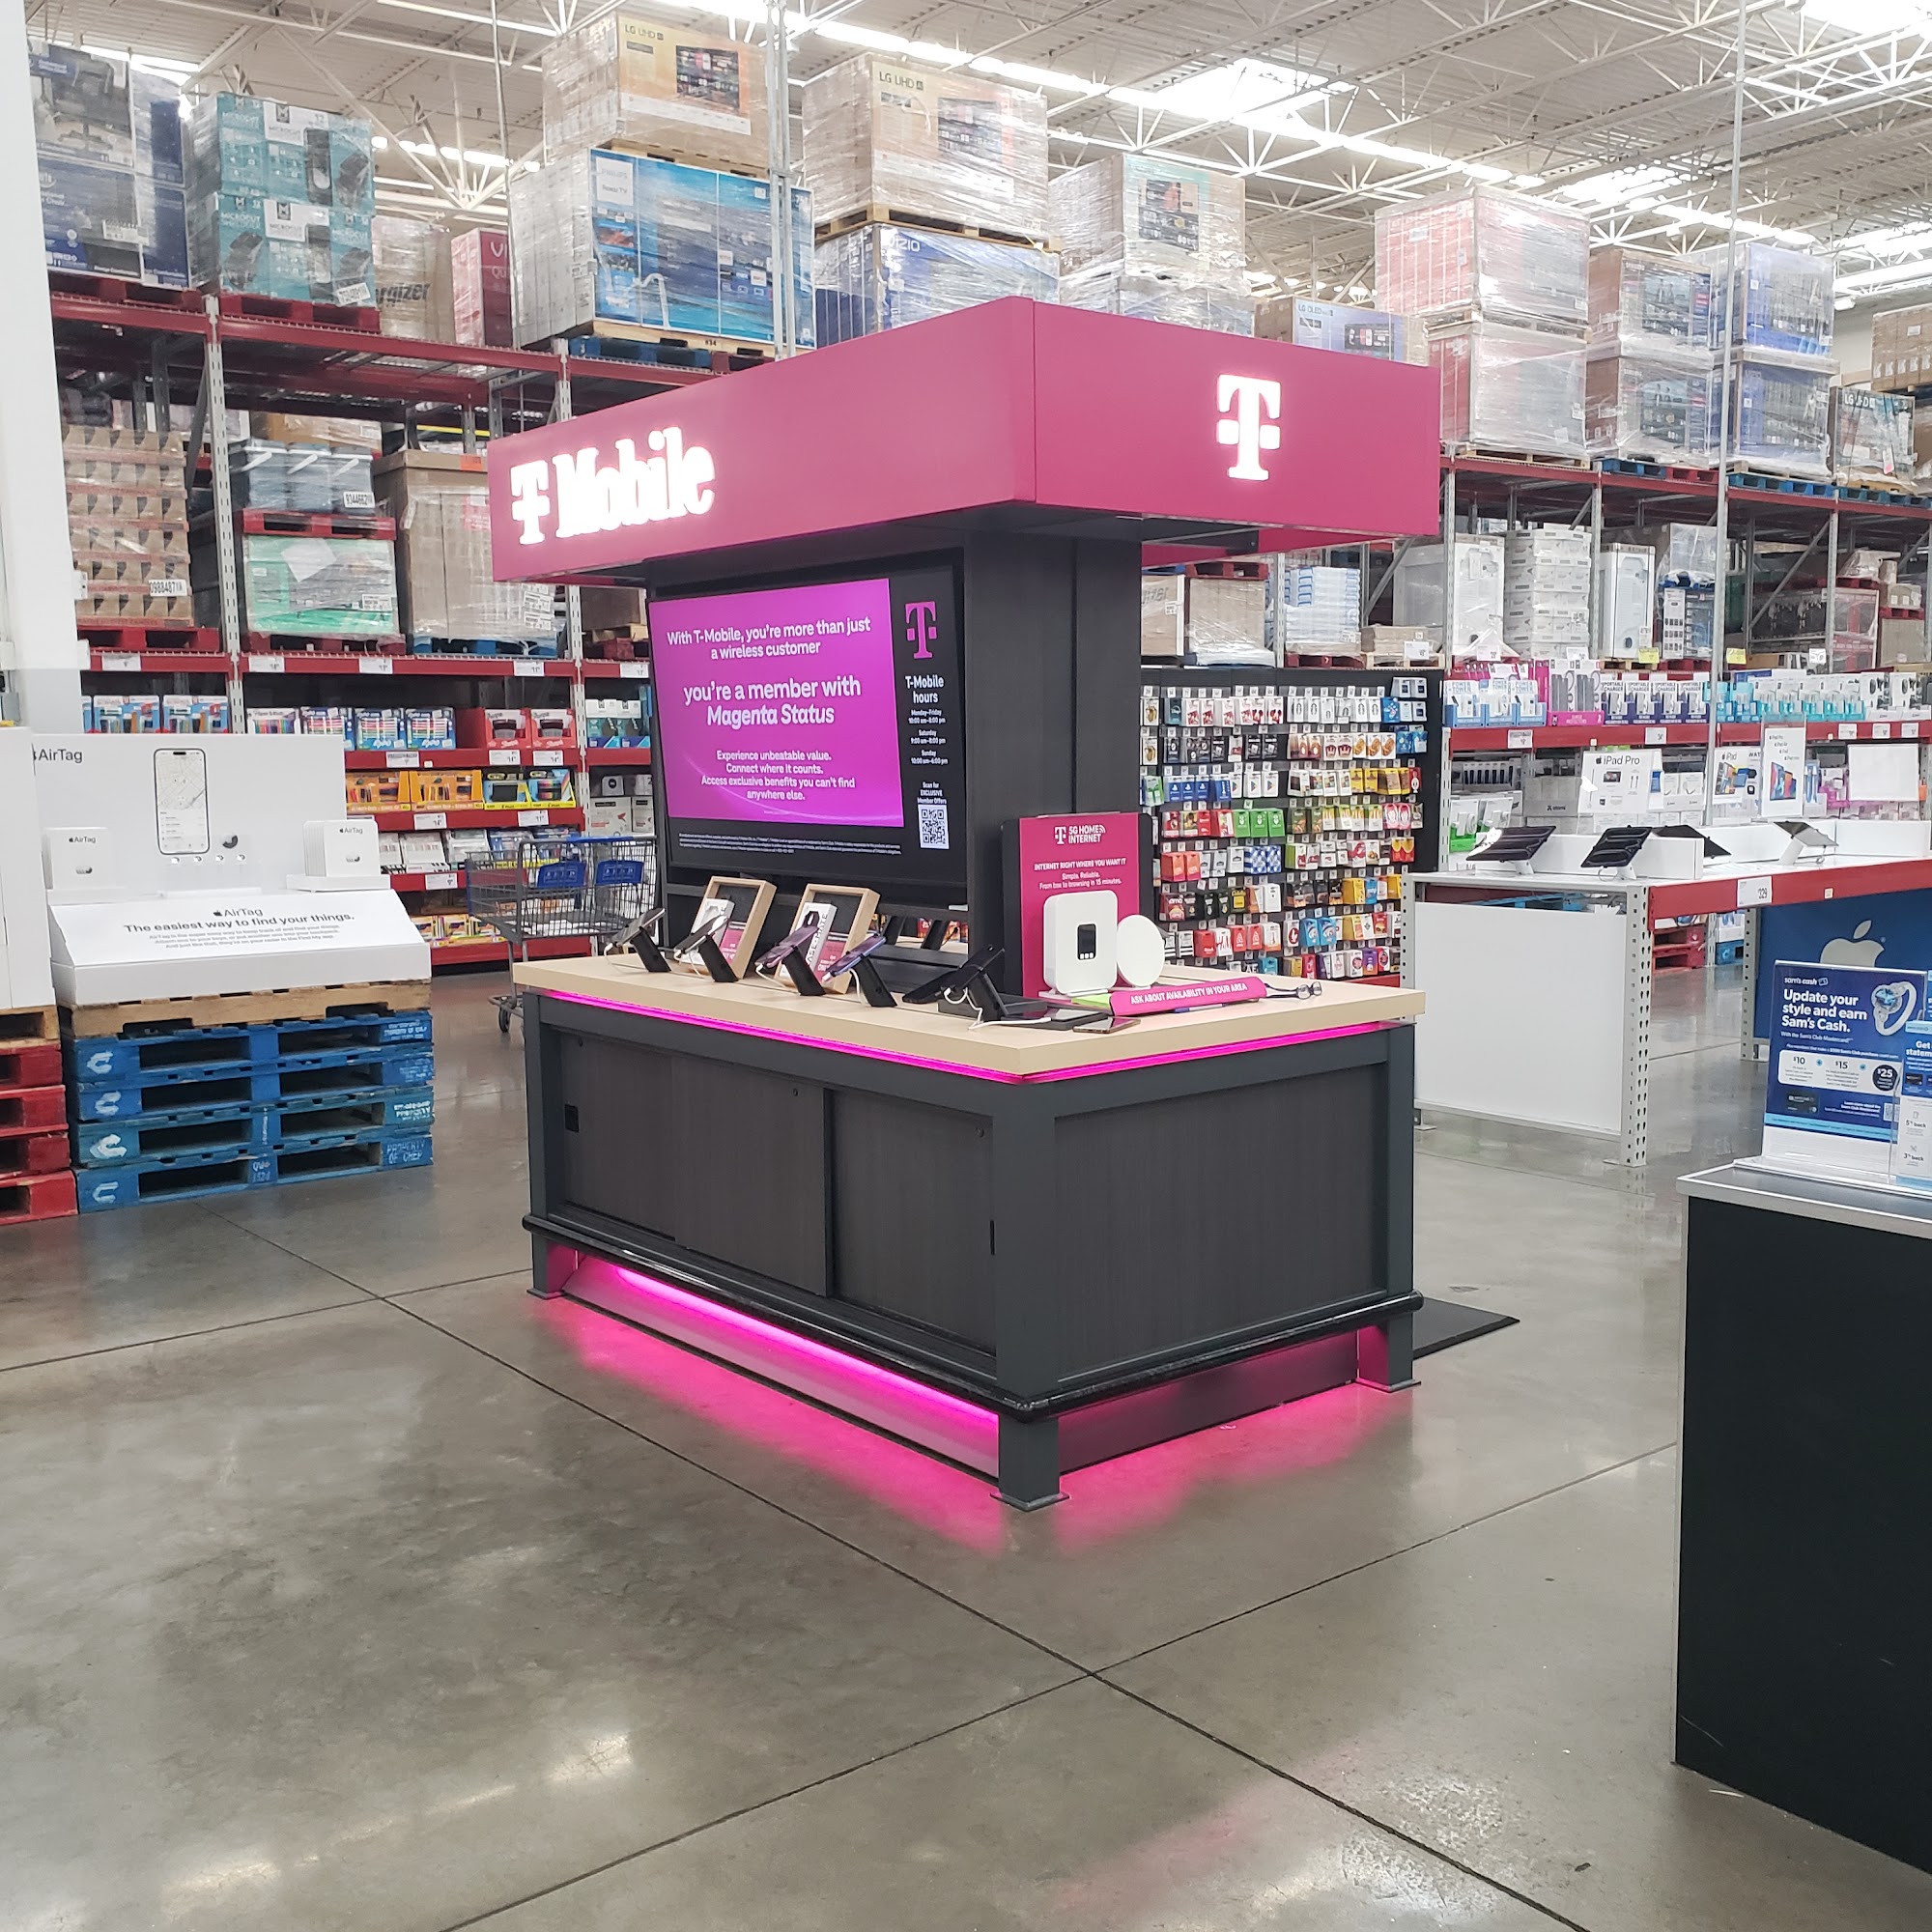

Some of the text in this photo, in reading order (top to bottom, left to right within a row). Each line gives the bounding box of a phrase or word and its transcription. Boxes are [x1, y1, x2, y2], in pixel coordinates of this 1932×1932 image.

[879, 71, 915, 89] LG UHD
[1844, 392, 1854, 405] LG
[1216, 374, 1282, 481] T
[552, 426, 716, 538] Mobile
[667, 615, 871, 645] With T-Mobile, you're more than just
[710, 640, 821, 660] a wireless customer
[905, 674, 945, 689] T-Mobile
[683, 675, 862, 705] you're a member with
[913, 691, 939, 704] hours
[706, 703, 835, 730] Magenta Status
[38, 748, 83, 764] AirTag
[716, 750, 833, 763] Experience unbeatable value.
[1604, 755, 1640, 765] iPad Pro
[725, 762, 824, 775] Connect where it counts.
[701, 775, 856, 790] Access exclusive benefits you can't find
[747, 789, 806, 801] anywhere else.
[344, 826, 363, 836] AirTag
[1068, 826, 1078, 835] 5G
[1078, 824, 1099, 834] HOME
[1067, 833, 1101, 844] INTERNET
[1034, 862, 1060, 871] INTERNET
[1094, 859, 1105, 867] YOU
[1105, 858, 1121, 867] WANT
[224, 908, 264, 917] AirTag
[124, 923, 152, 933] The
[154, 922, 204, 931] easiest
[251, 917, 277, 925] find
[278, 916, 309, 924] your
[1130, 982, 1248, 1005] ASK ABOUT AVAILABILITY IN YOUR AREA
[1783, 988, 1859, 1007] Update your
[1781, 1003, 1867, 1020] style and earn
[1781, 1014, 1851, 1033] Sam's Cash.
[1916, 1040, 1931, 1049] Get
[1793, 1056, 1893, 1078] $10 $15 $25
